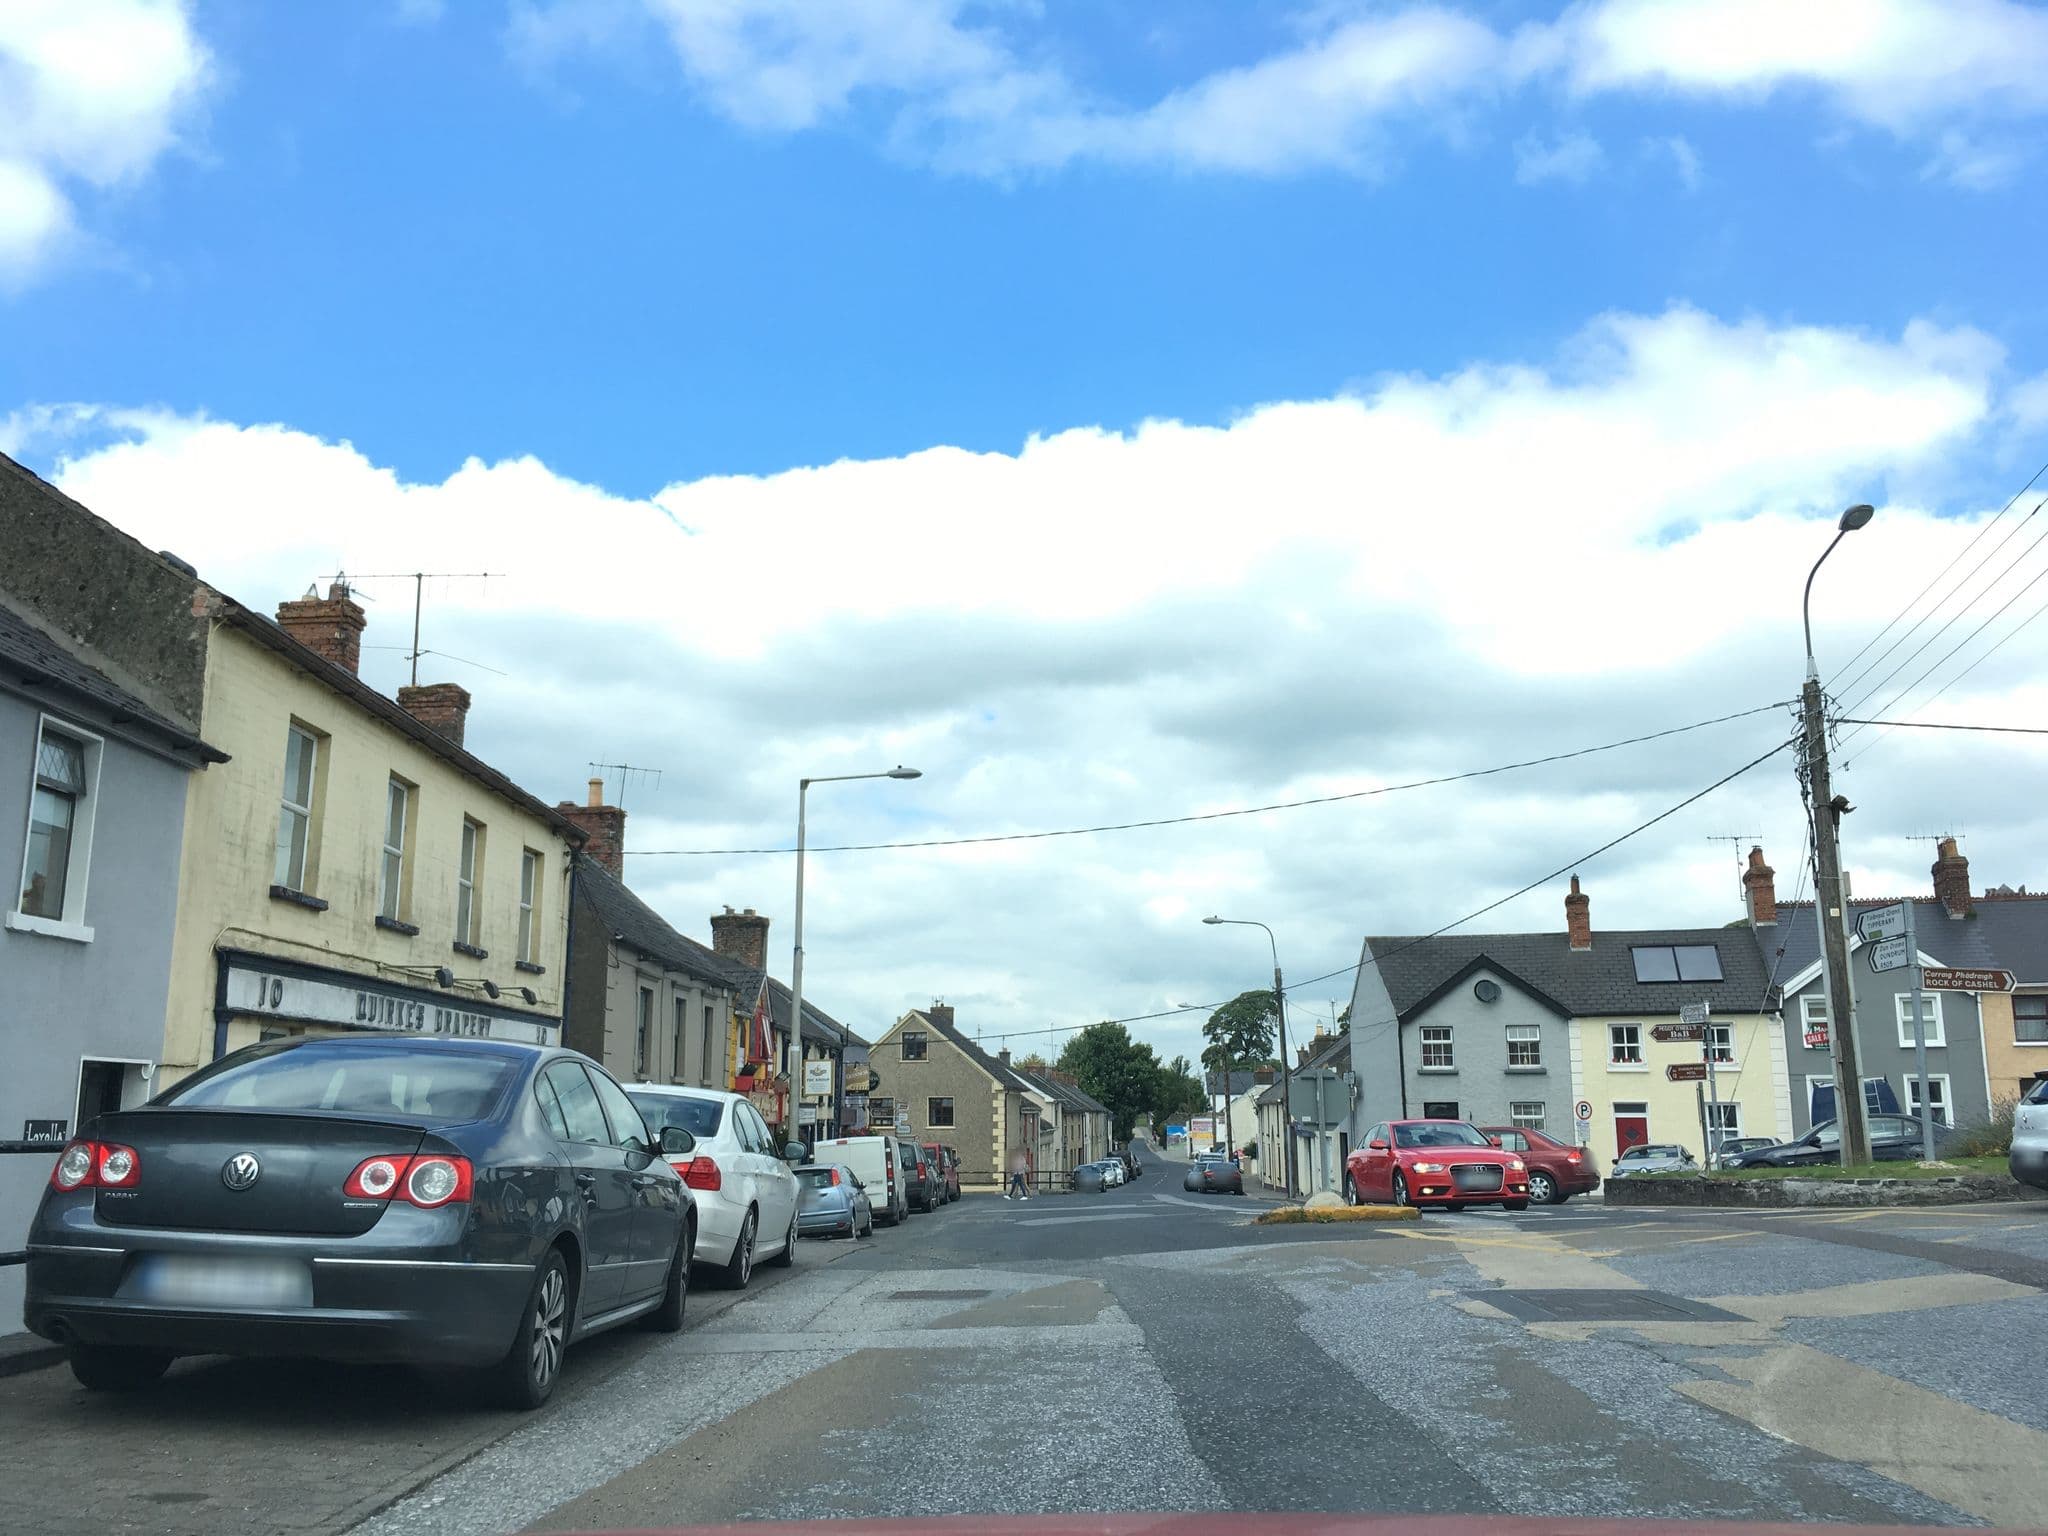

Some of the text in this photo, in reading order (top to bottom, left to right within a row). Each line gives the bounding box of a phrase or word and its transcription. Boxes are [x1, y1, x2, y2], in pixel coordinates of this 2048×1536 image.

[1867, 917, 1895, 929] TIPPERARY
[1880, 949, 1905, 960] DUNDRUM
[1924, 970, 1952, 979] Carraig
[1964, 981, 2000, 989] CASHEL
[259, 976, 283, 1008] 10
[435, 1008, 492, 1037] DRAPERY
[1806, 1033, 1823, 1043] SALE
